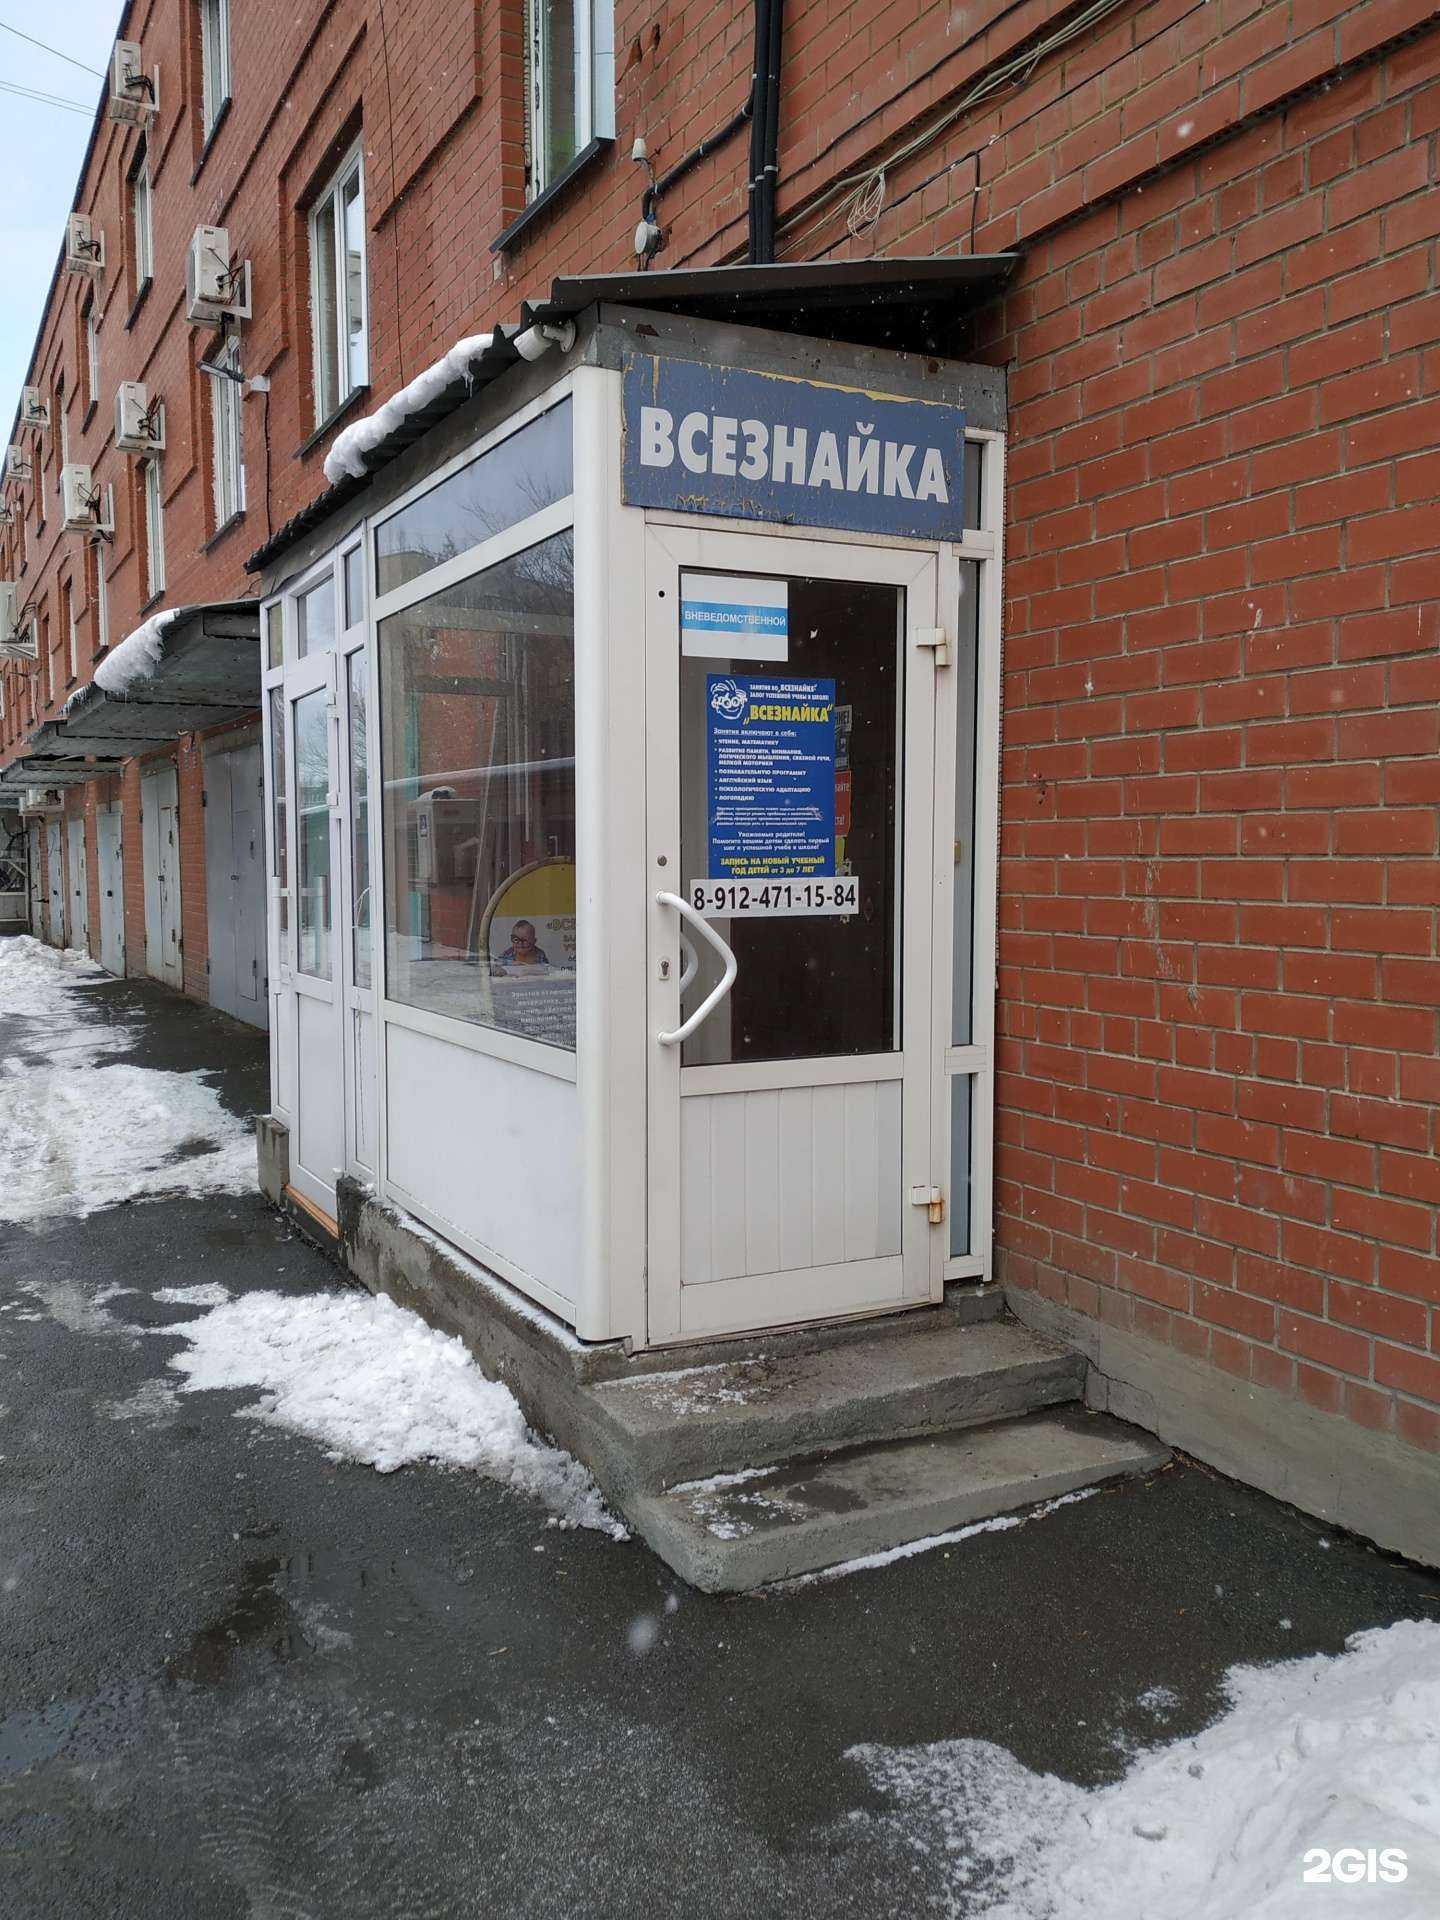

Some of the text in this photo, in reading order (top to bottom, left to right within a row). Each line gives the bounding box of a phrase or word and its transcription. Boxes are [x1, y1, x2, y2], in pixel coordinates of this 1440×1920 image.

[640, 406, 949, 504] ВСЕЗНАЙКА
[685, 610, 786, 627] ВНЕВЕДОМСТВЕННОЙ
[713, 727, 740, 735] Занятия
[720, 855, 825, 866] ЗАПИСЬ НА НОВЫЙ УЧЕБНЫЙ
[731, 867, 747, 875] ГОД
[747, 866, 770, 875] ДЕТЕЙ
[694, 884, 856, 911] 8-912-471-15-84
